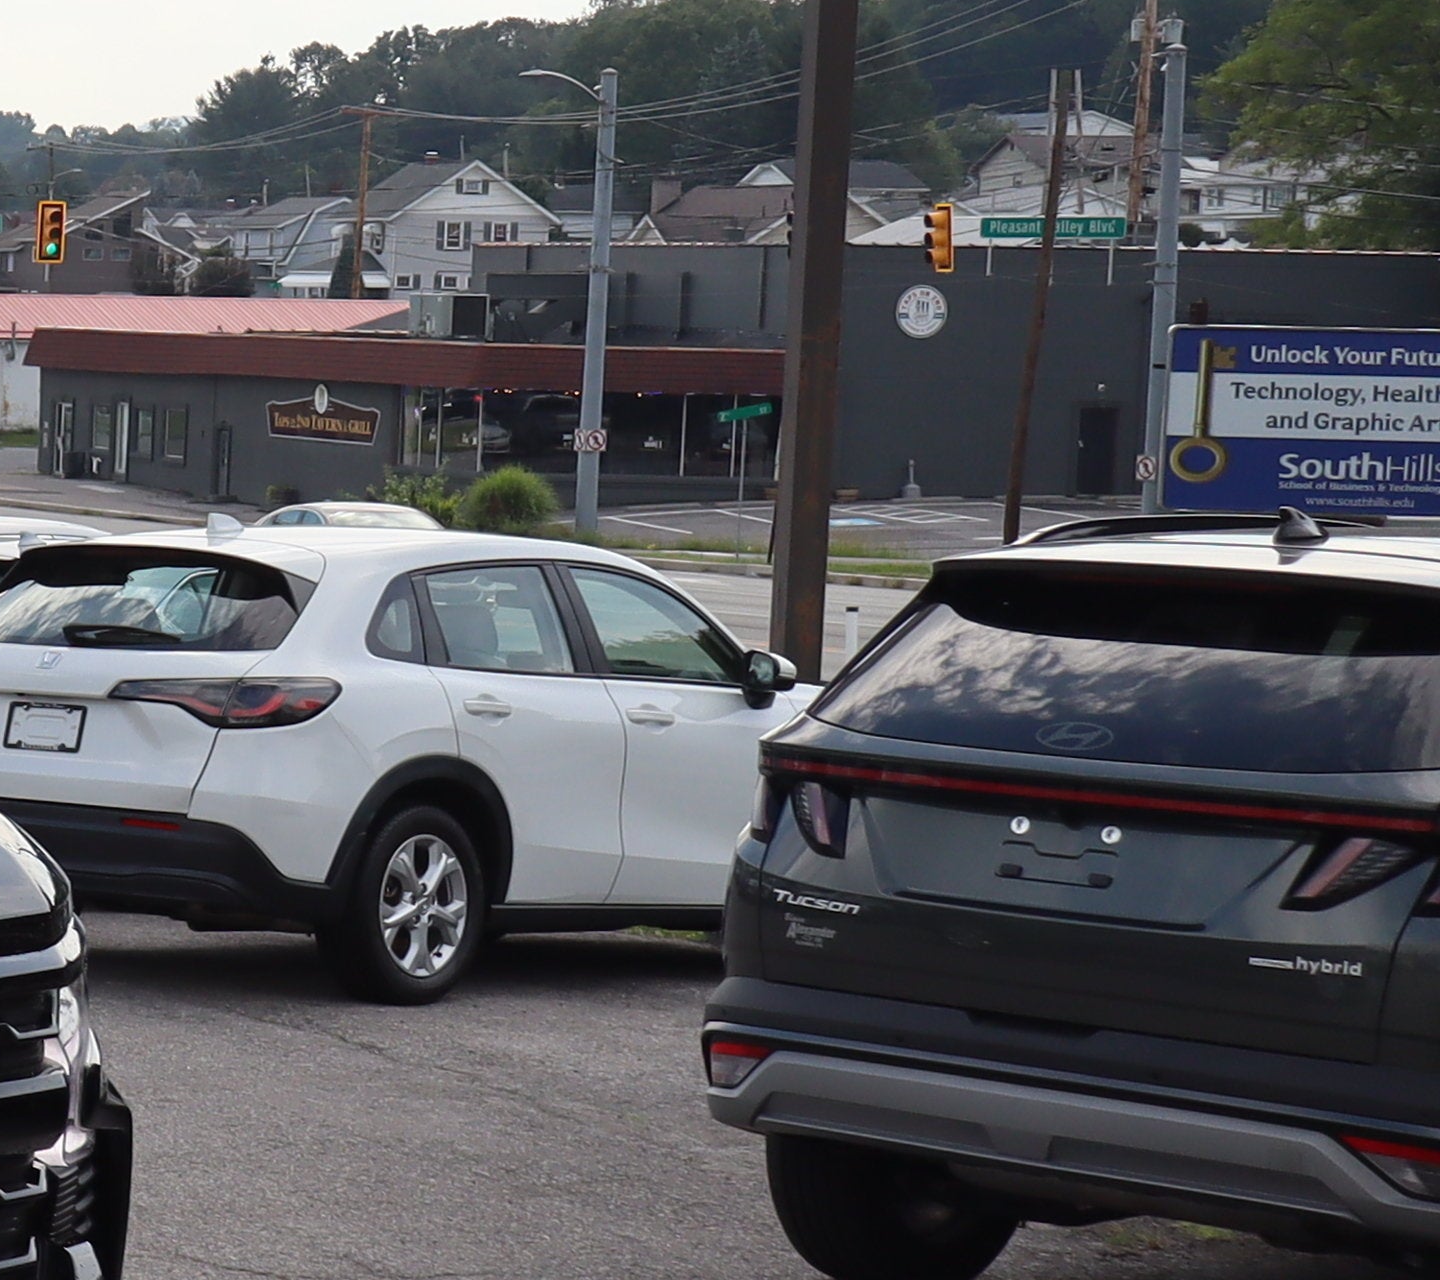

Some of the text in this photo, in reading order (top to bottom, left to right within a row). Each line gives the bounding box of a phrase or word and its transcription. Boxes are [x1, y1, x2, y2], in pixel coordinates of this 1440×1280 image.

[989, 220, 1041, 234] Pleasant
[1053, 220, 1084, 236] alley
[1250, 344, 1329, 365] Unlock
[1333, 346, 1387, 366] Your
[1230, 381, 1366, 407] Technology,
[1265, 410, 1440, 435] and Graphic Ar
[1278, 480, 1313, 490] School
[1315, 480, 1326, 490] of
[1329, 482, 1375, 492] Business
[1295, 955, 1363, 977] hybrid
